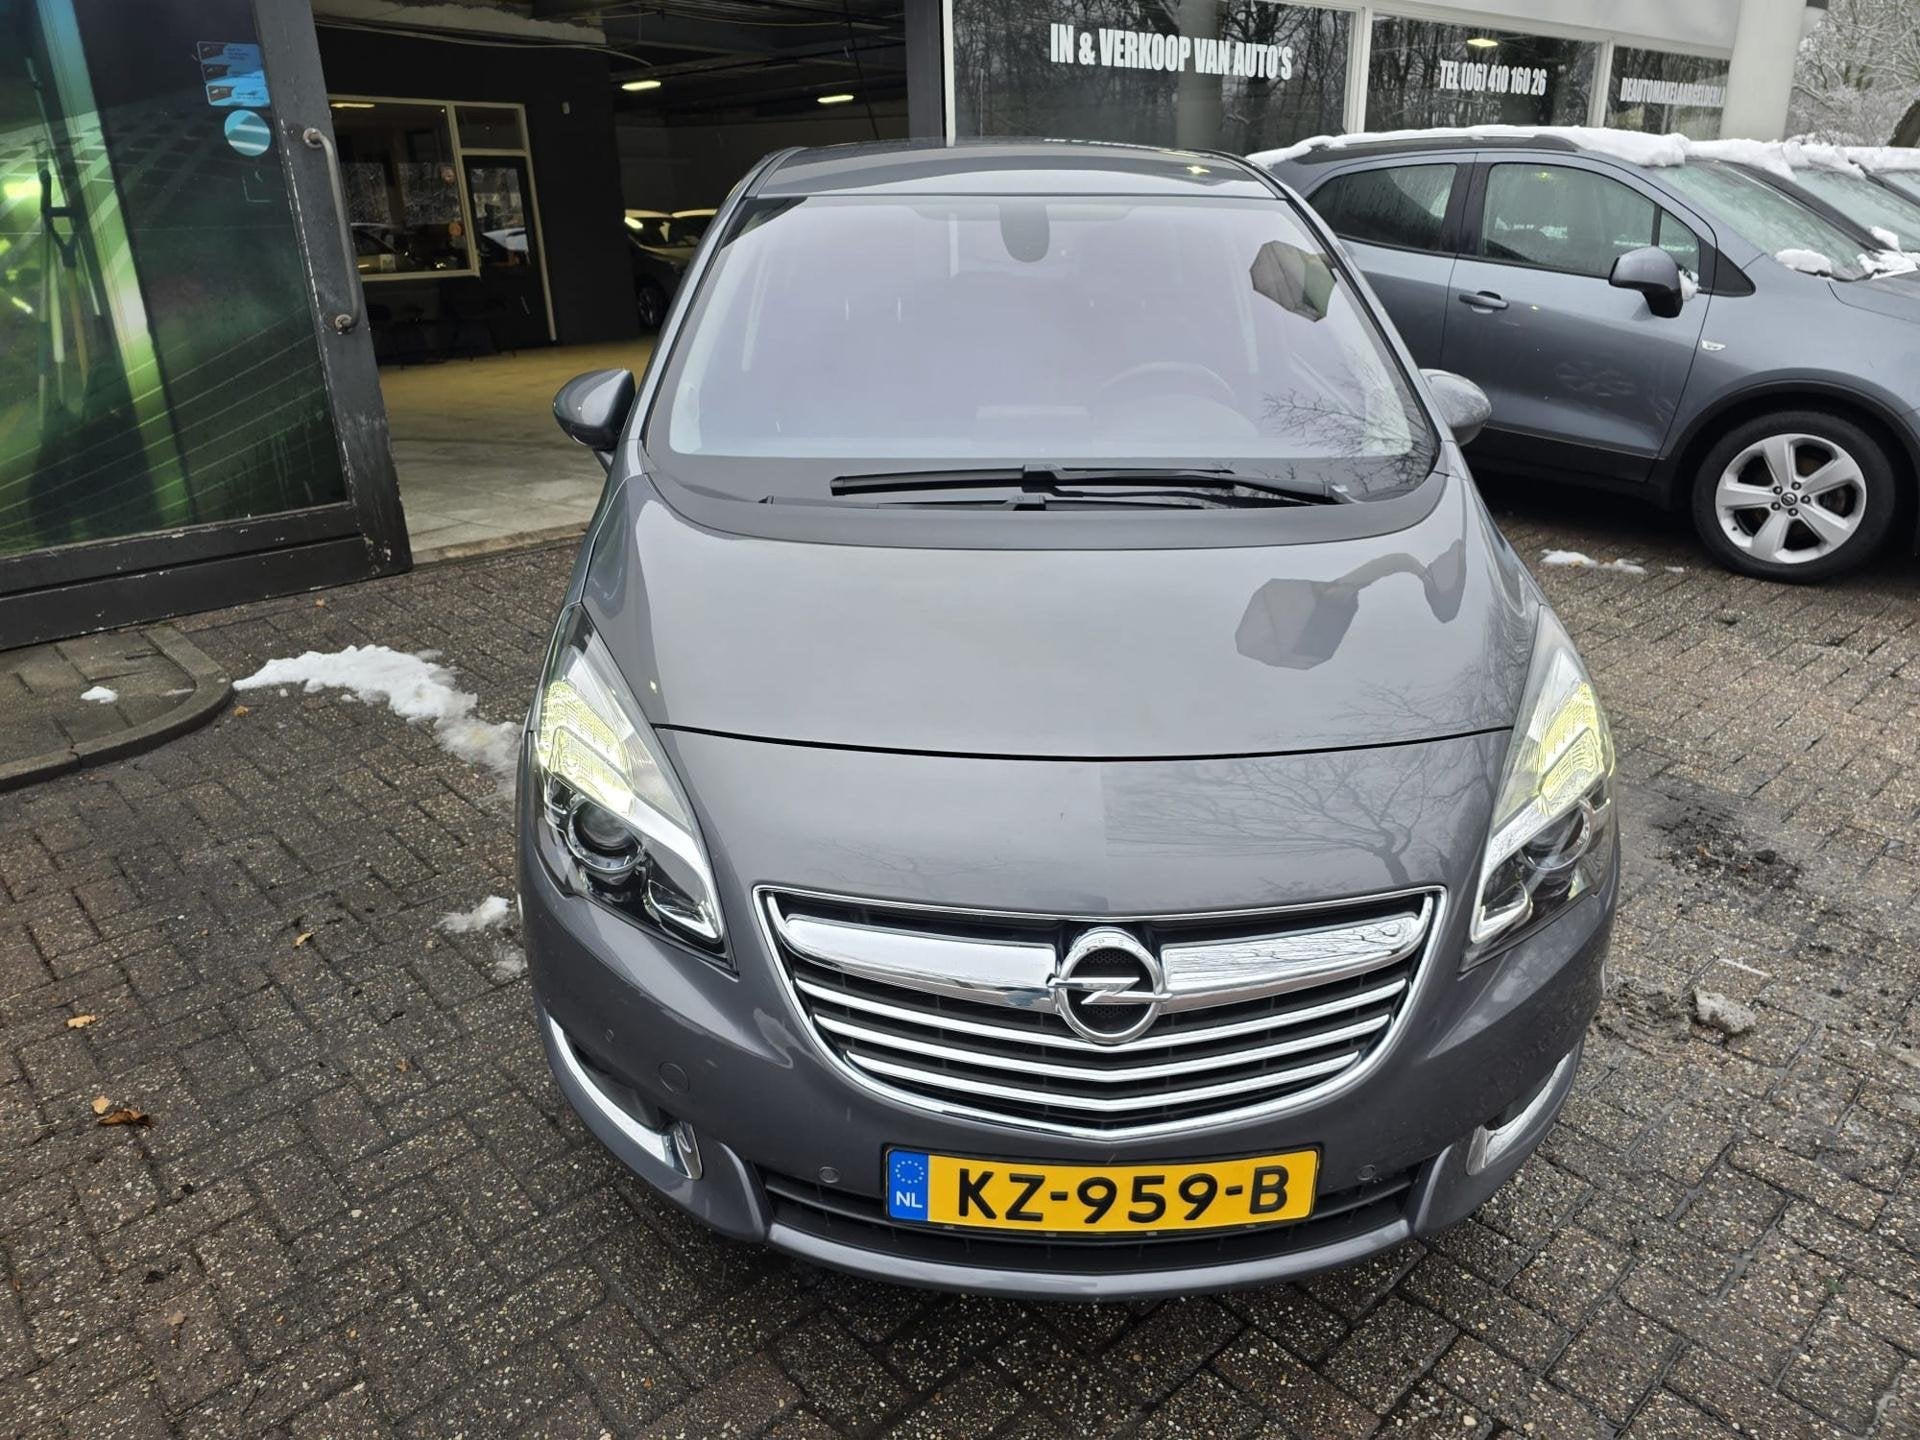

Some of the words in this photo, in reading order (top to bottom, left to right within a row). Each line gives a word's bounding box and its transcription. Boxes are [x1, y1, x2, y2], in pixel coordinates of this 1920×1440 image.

[1050, 23, 1073, 63] IN
[1079, 32, 1096, 66] &
[1099, 28, 1191, 72] VERKOOP
[1194, 38, 1230, 75] VAN
[1232, 42, 1293, 80] AUTO'S
[1440, 59, 1459, 90] TEL
[1461, 62, 1488, 92] (06)
[1488, 65, 1509, 93] 410
[1510, 66, 1531, 95] 160
[1530, 68, 1548, 96] 26
[896, 1190, 923, 1209] NL
[958, 1165, 1290, 1224] KZ-959-B
